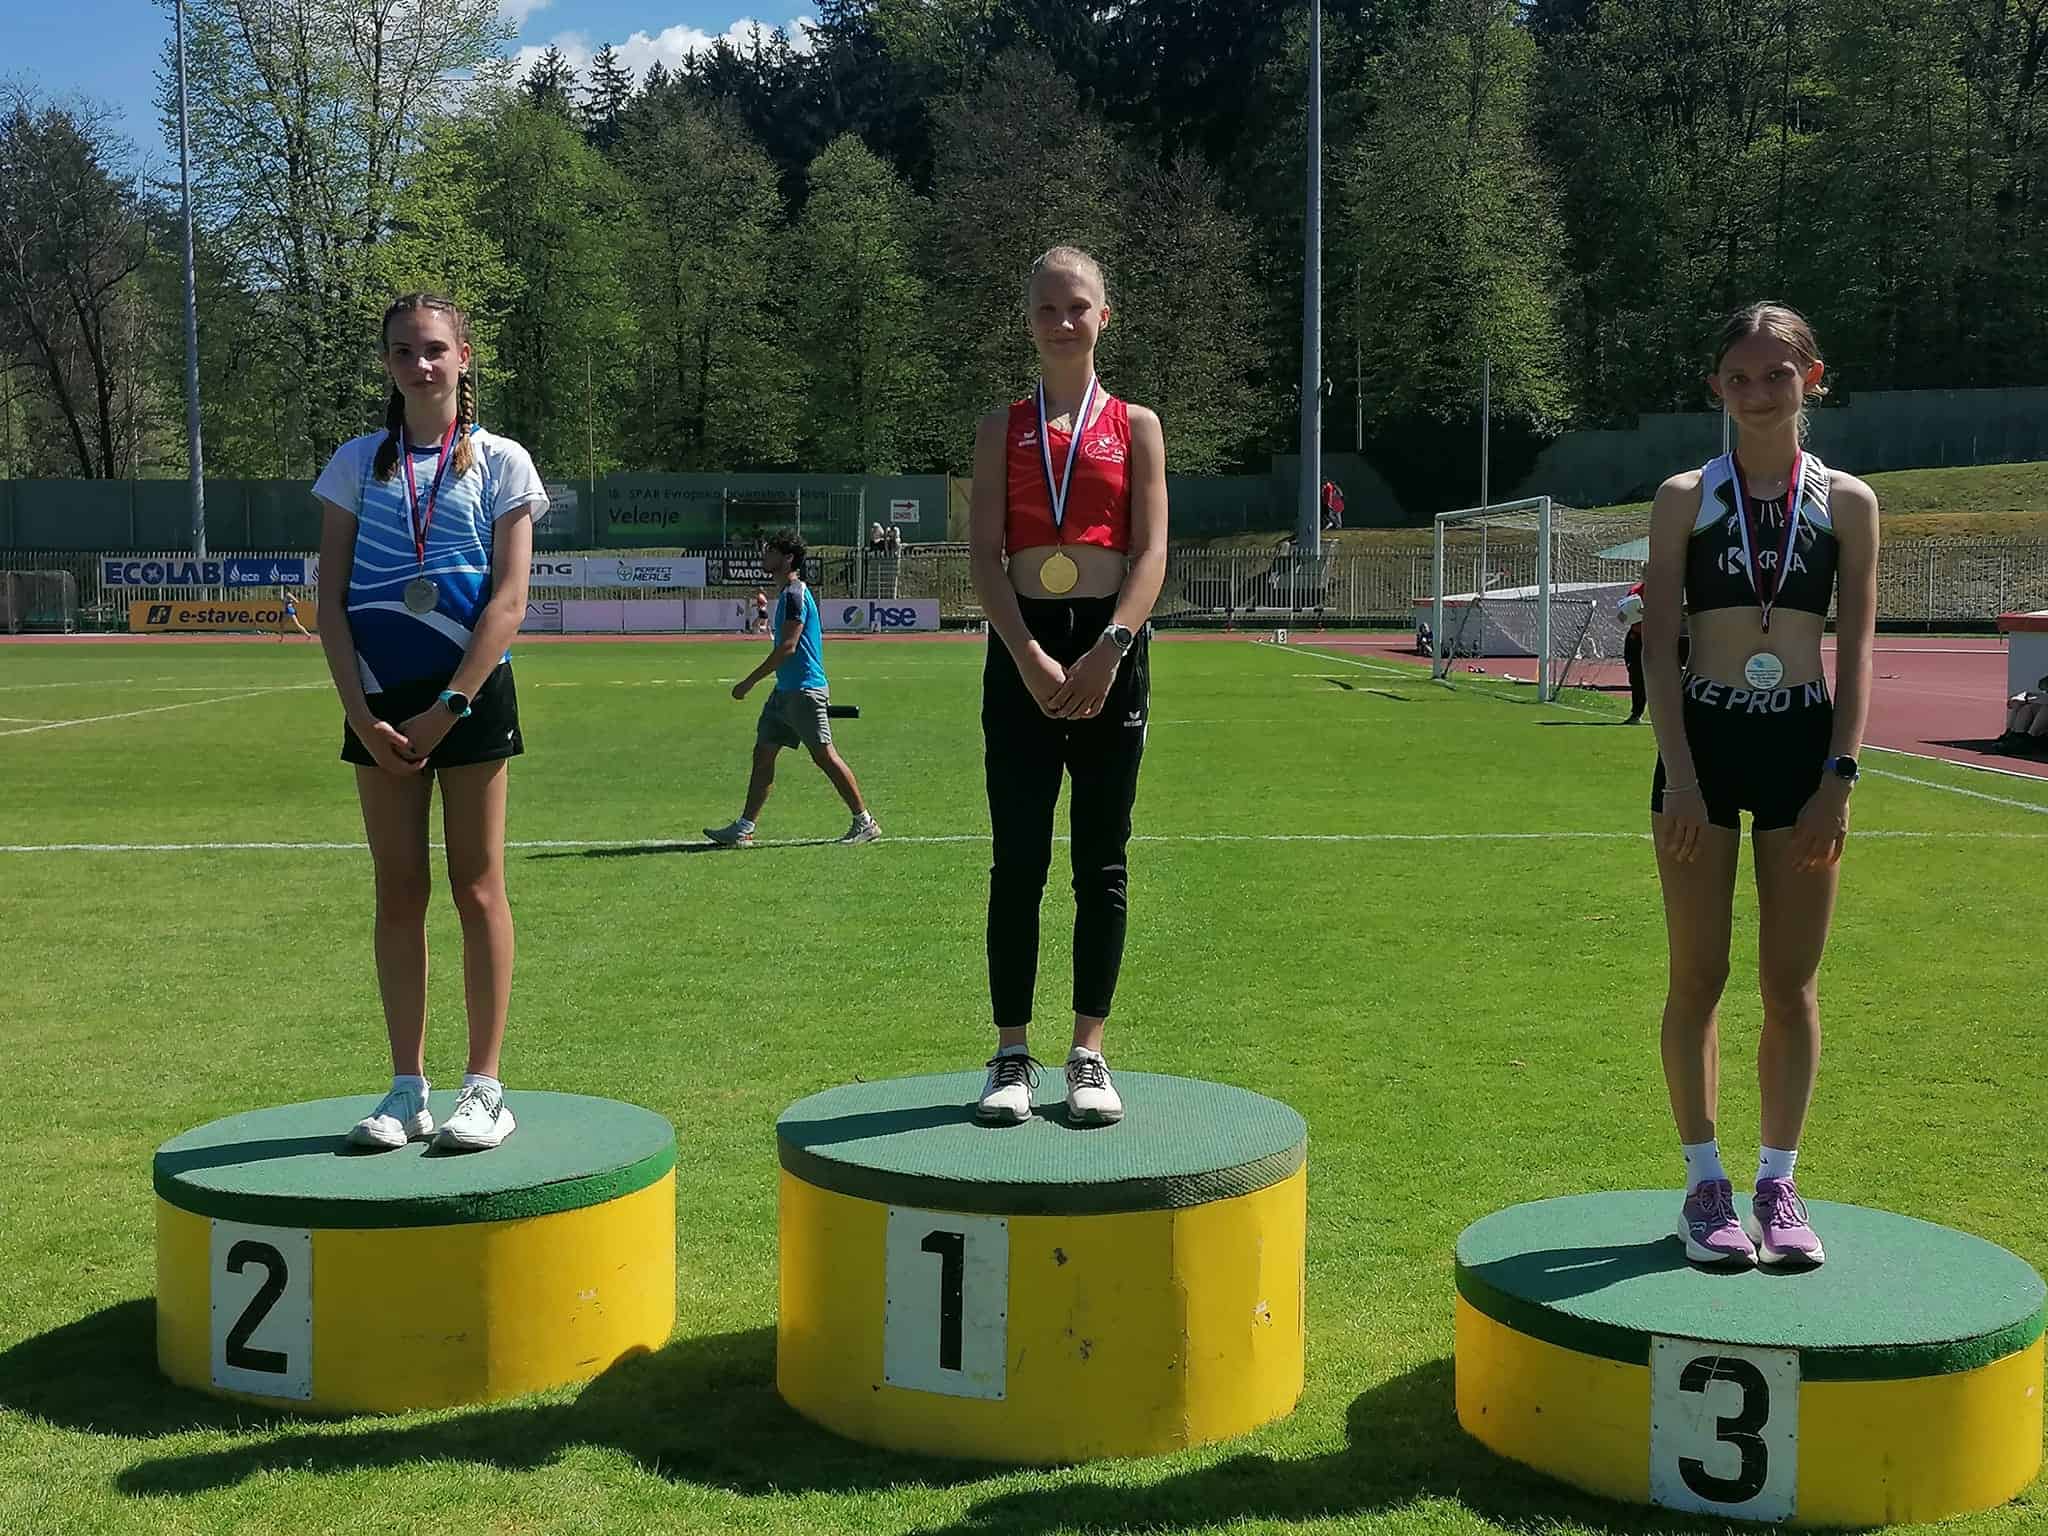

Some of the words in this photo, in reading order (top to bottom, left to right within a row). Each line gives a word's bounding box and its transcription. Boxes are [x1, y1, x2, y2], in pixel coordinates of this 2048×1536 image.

[608, 505, 680, 528] Velenje
[104, 561, 221, 584] ECOLAB
[870, 601, 917, 627] hse
[1725, 688, 1791, 715] PRO
[226, 1239, 288, 1374] 2
[920, 1230, 964, 1370] 1
[1679, 1355, 1769, 1503] 3
